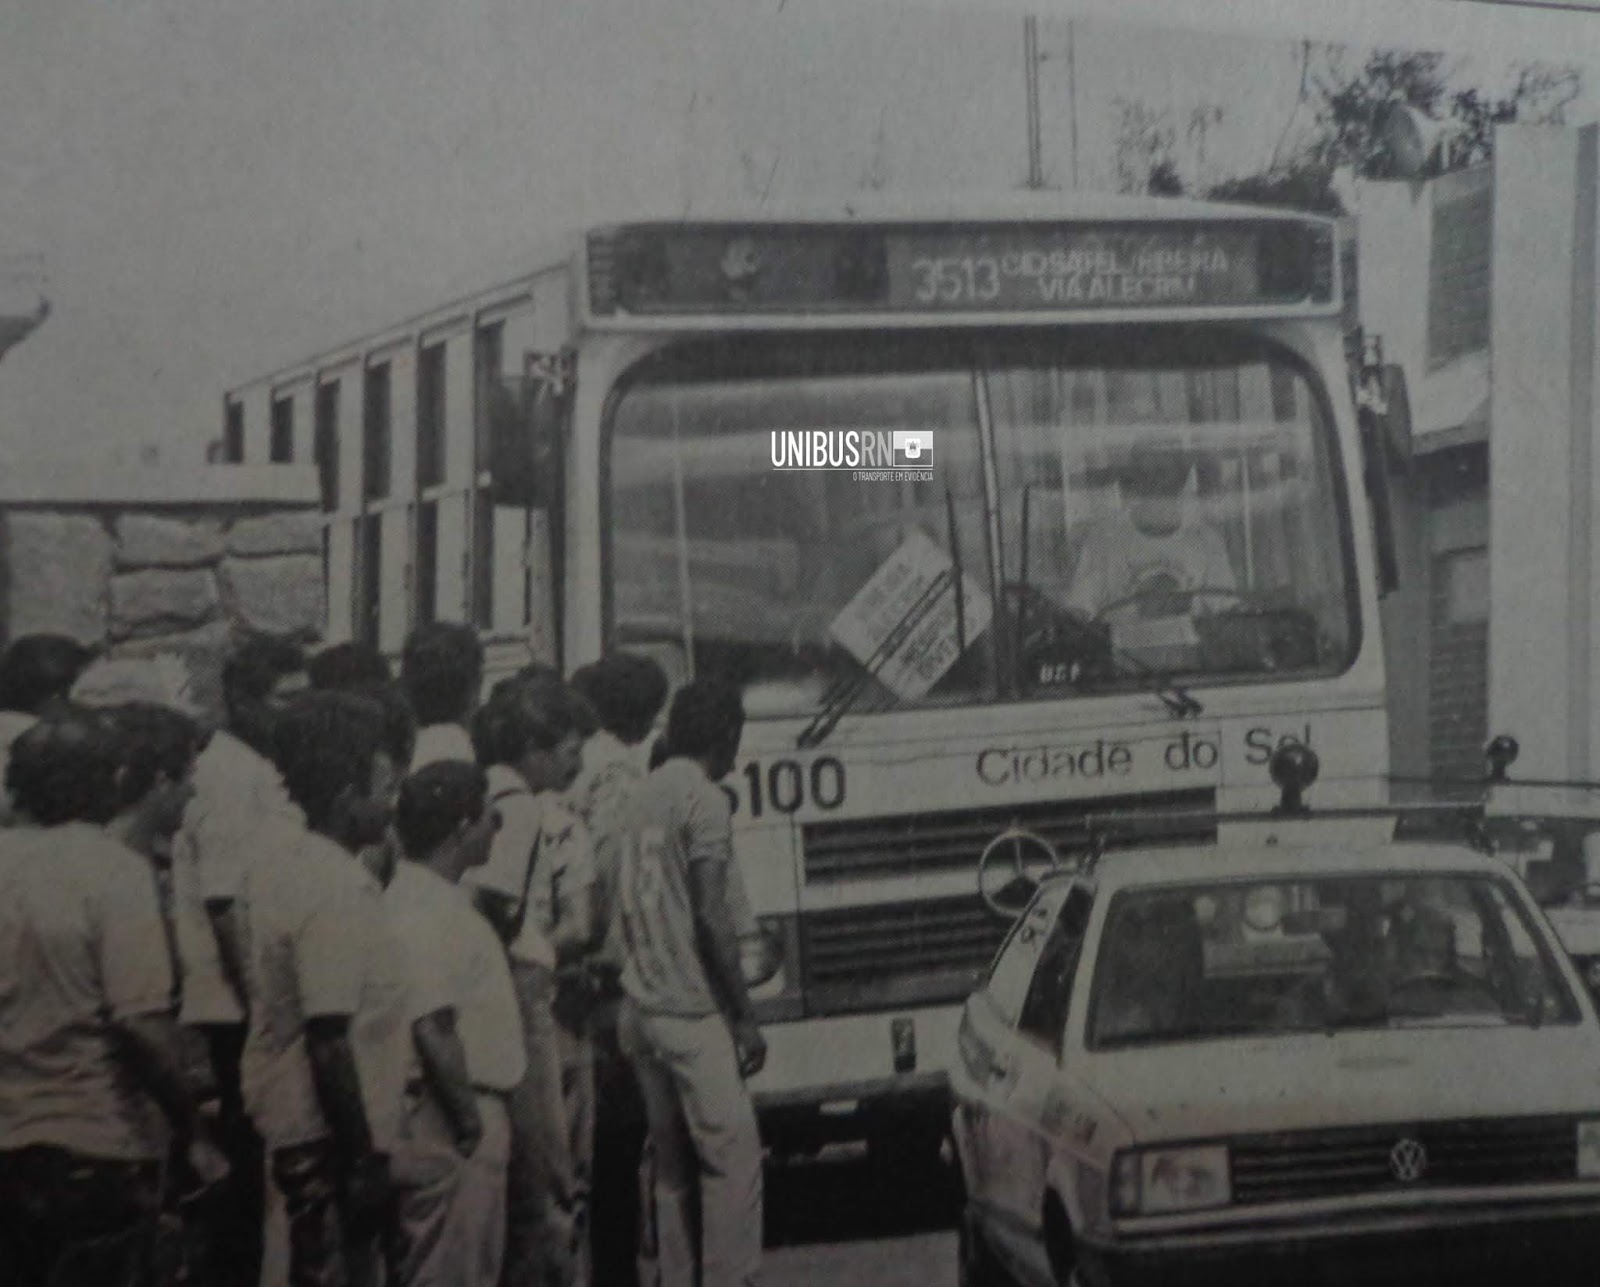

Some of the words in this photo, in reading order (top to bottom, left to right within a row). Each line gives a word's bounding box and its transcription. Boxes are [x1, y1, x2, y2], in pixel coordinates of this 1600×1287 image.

[912, 255, 1000, 303] 3513
[1037, 276, 1082, 302] VIA
[974, 740, 1134, 787] Cidade
[1163, 732, 1220, 771] do
[719, 756, 846, 818] 100
